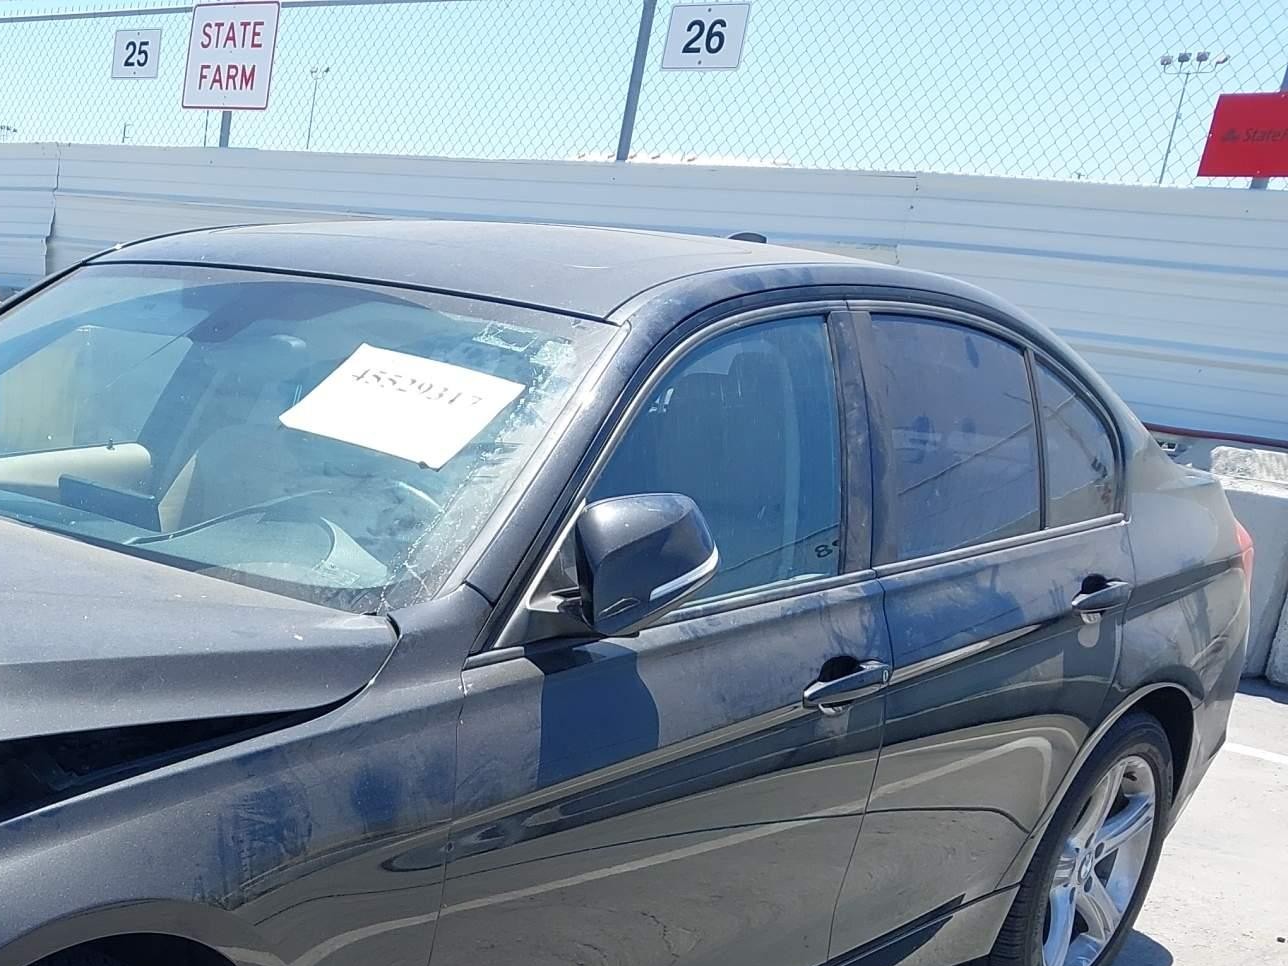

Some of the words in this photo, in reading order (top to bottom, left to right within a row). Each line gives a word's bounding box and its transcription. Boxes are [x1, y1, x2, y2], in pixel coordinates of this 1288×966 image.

[200, 21, 265, 49] STATE
[681, 18, 727, 55] 26
[123, 40, 150, 67] 25
[198, 64, 256, 91] FARM
